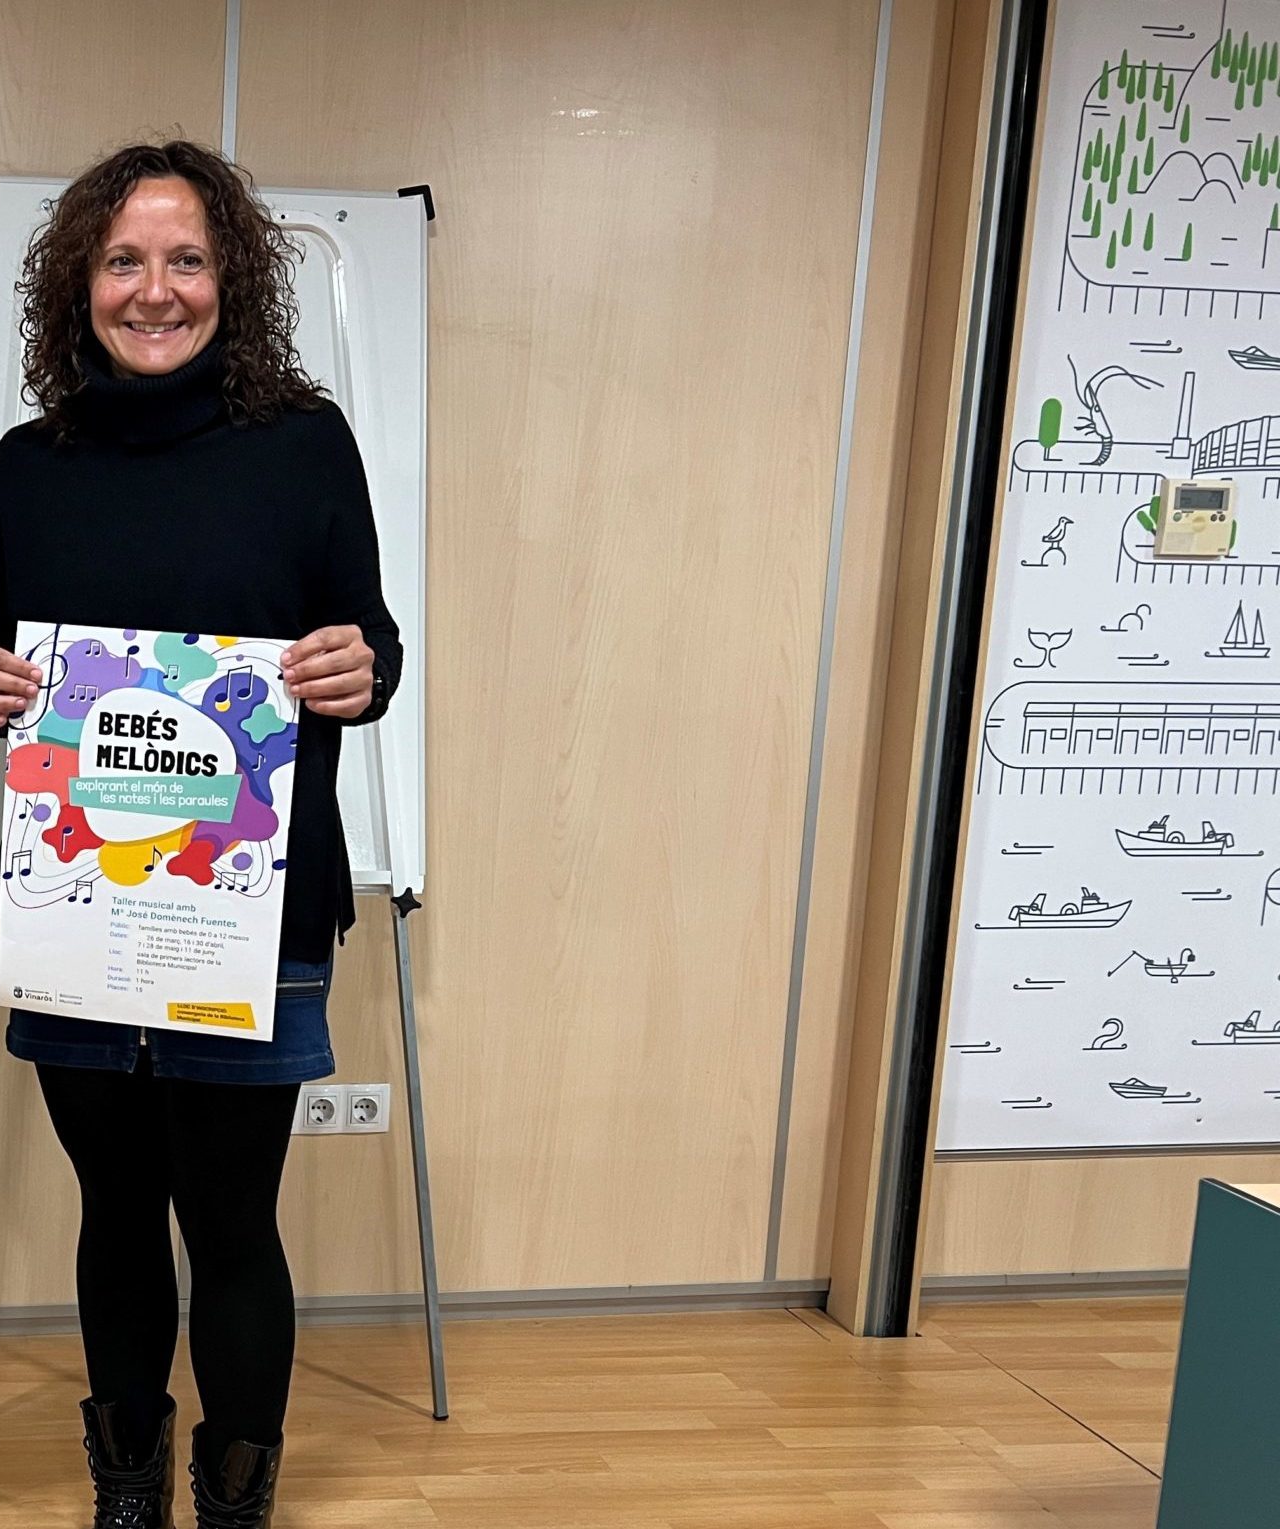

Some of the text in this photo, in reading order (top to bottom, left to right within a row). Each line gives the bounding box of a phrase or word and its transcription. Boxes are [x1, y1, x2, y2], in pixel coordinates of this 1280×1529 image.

[98, 709, 178, 741] BEBÉS
[96, 741, 218, 777] MELÒDICS
[75, 779, 183, 794] explorant el món de
[100, 791, 228, 808] les notes i les paraules
[112, 896, 196, 912] Taller musical amb
[126, 909, 148, 919] José
[150, 912, 198, 924] Domènech
[201, 917, 237, 928] Fuentes
[136, 959, 198, 971] Biblioteca Municipal
[159, 954, 183, 962] primers
[184, 956, 205, 964] lectors
[140, 977, 155, 985] hora
[24, 992, 53, 1002] Vinaròs
